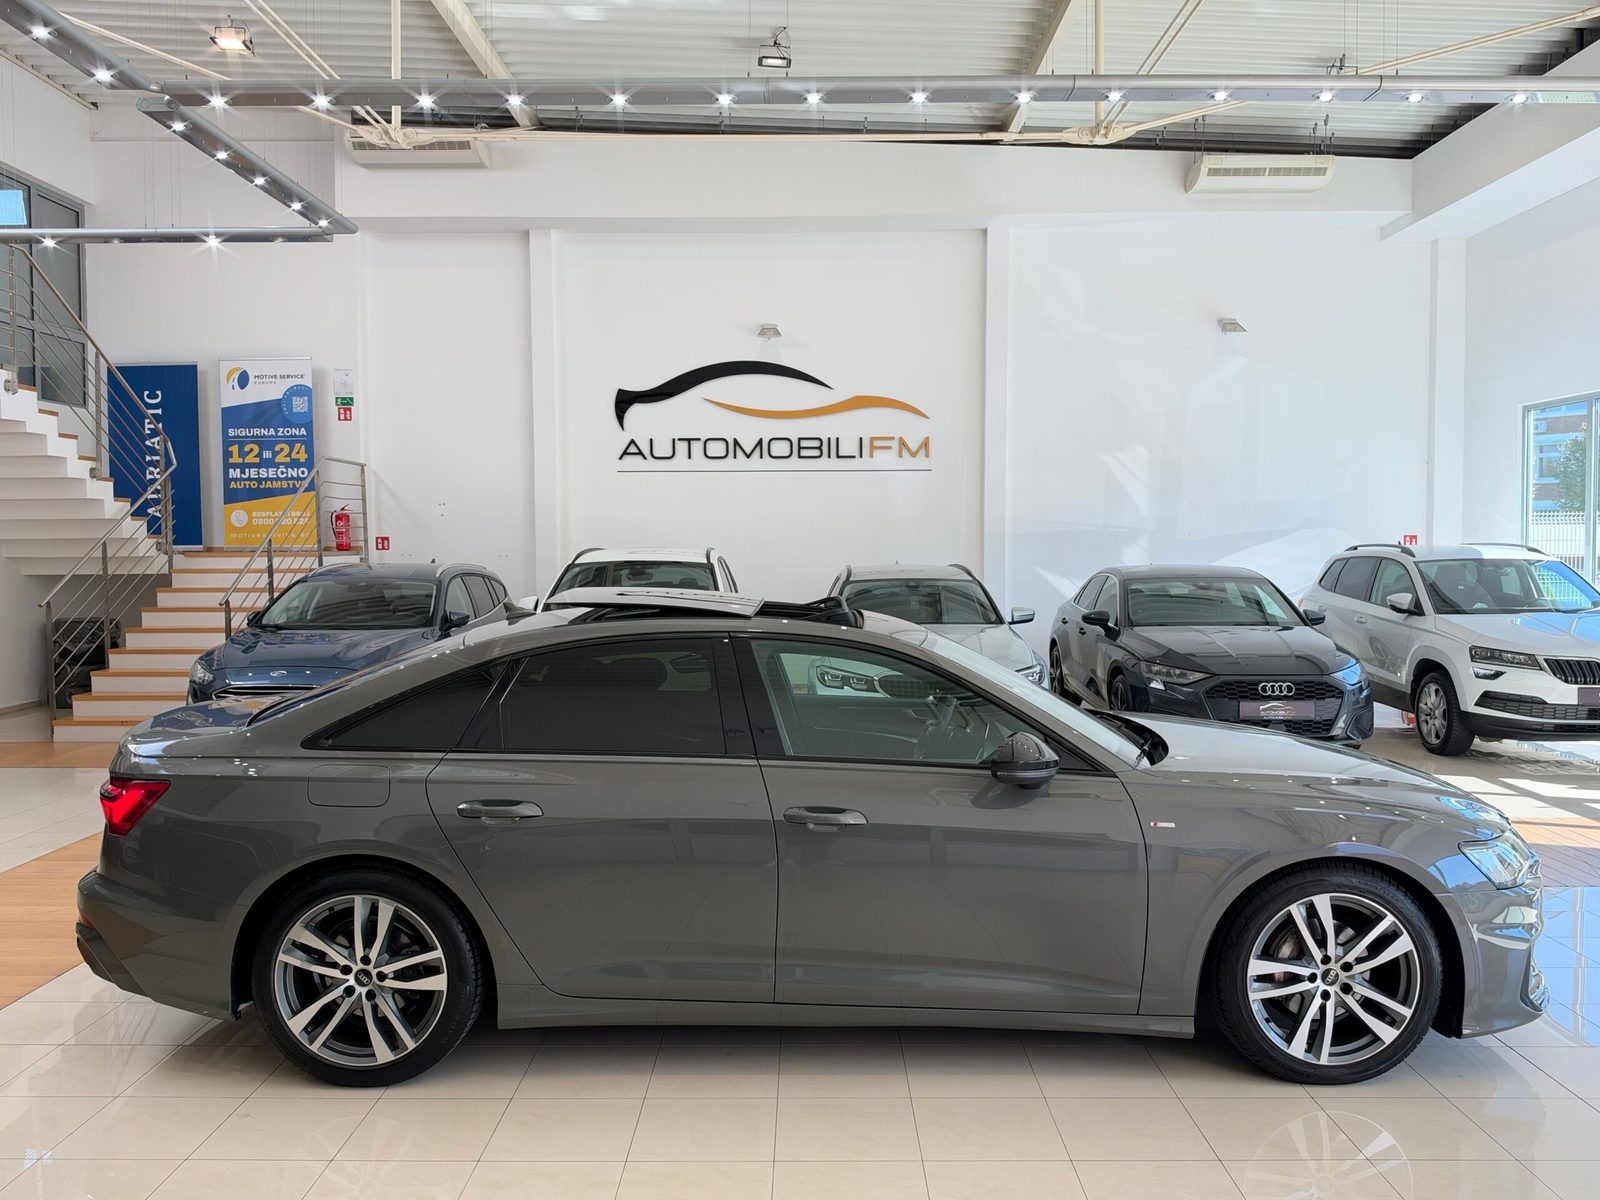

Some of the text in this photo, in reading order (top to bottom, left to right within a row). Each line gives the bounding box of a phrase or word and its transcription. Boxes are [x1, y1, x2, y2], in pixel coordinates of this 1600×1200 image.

[228, 427, 307, 437] SIGURNA ZONA
[228, 443, 308, 463] 12 ili 24
[618, 436, 930, 460] AUTOMOBILIFM
[229, 465, 309, 478] MJESEČNO
[229, 480, 258, 489] AUTO
